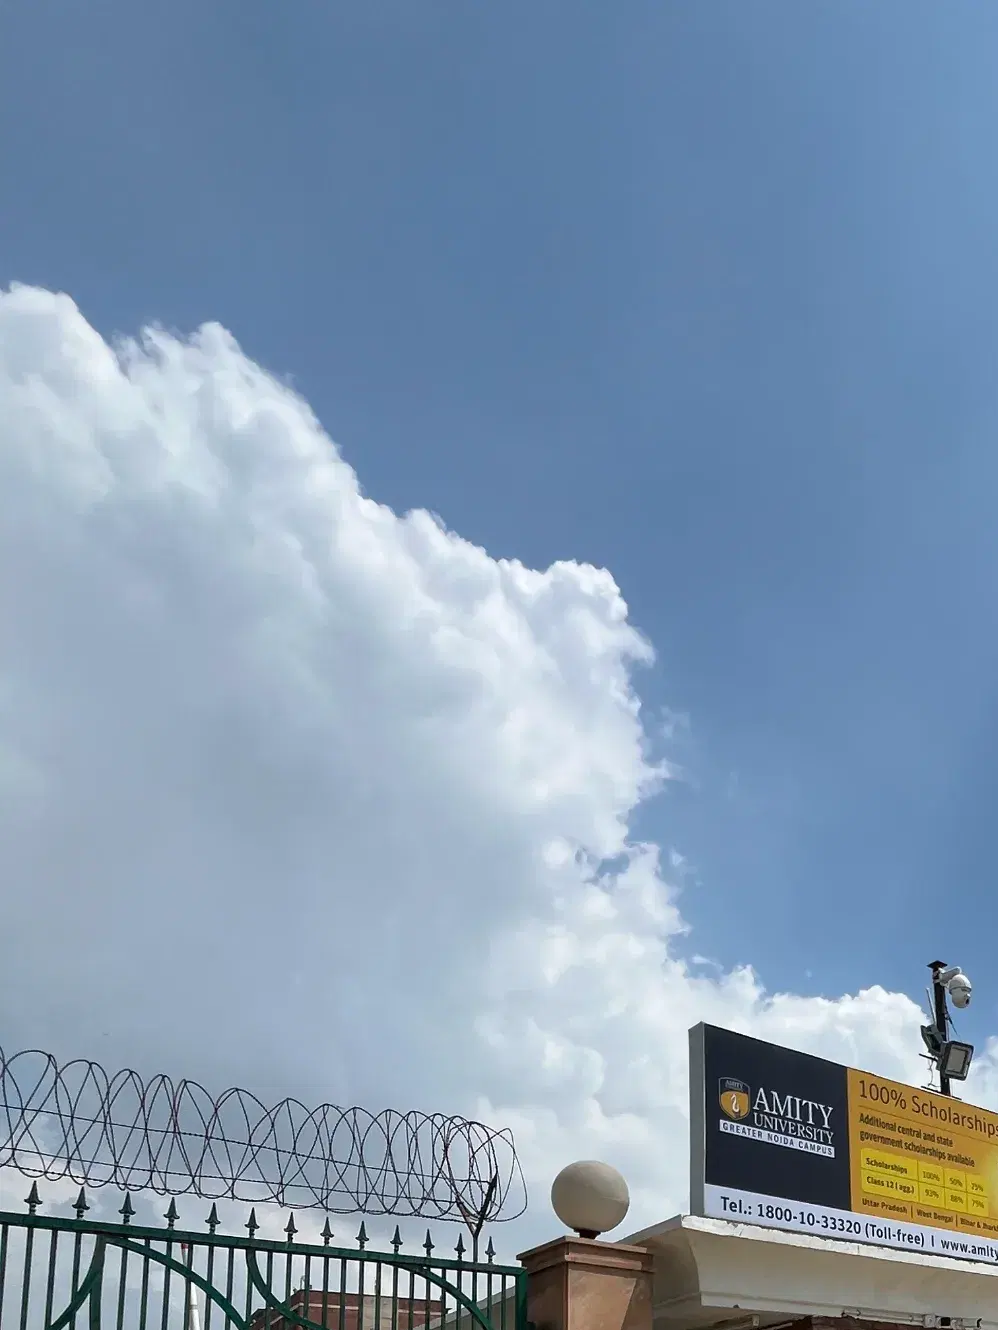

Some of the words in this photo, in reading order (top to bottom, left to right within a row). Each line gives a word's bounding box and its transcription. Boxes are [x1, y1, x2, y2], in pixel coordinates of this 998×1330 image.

[753, 1087, 834, 1129] AMITY
[860, 1080, 907, 1110] 100%
[722, 1122, 763, 1140] GREATER
[767, 1133, 795, 1147] NOIDA
[798, 1140, 833, 1156] CAMPUS
[753, 1112, 834, 1145] UNIVERSITY
[859, 1113, 896, 1132] Additional
[897, 1124, 922, 1139] central
[922, 1131, 936, 1143] and
[936, 1135, 954, 1148] state
[859, 1130, 903, 1150] government
[904, 1140, 947, 1160] scholarships
[947, 1152, 975, 1167] available
[865, 1157, 908, 1174] Scholarships
[922, 1170, 941, 1182] 100%
[866, 1175, 885, 1188] Class
[886, 1179, 894, 1188] 12
[720, 1195, 753, 1216] Tel.:
[757, 1203, 862, 1234] 1800-10-33320
[865, 1223, 925, 1249] (Toll-free)
[862, 1198, 880, 1209] Uttar
[881, 1202, 908, 1214] Pradesh
[916, 1208, 932, 1219] West
[933, 1211, 954, 1223] Bengal
